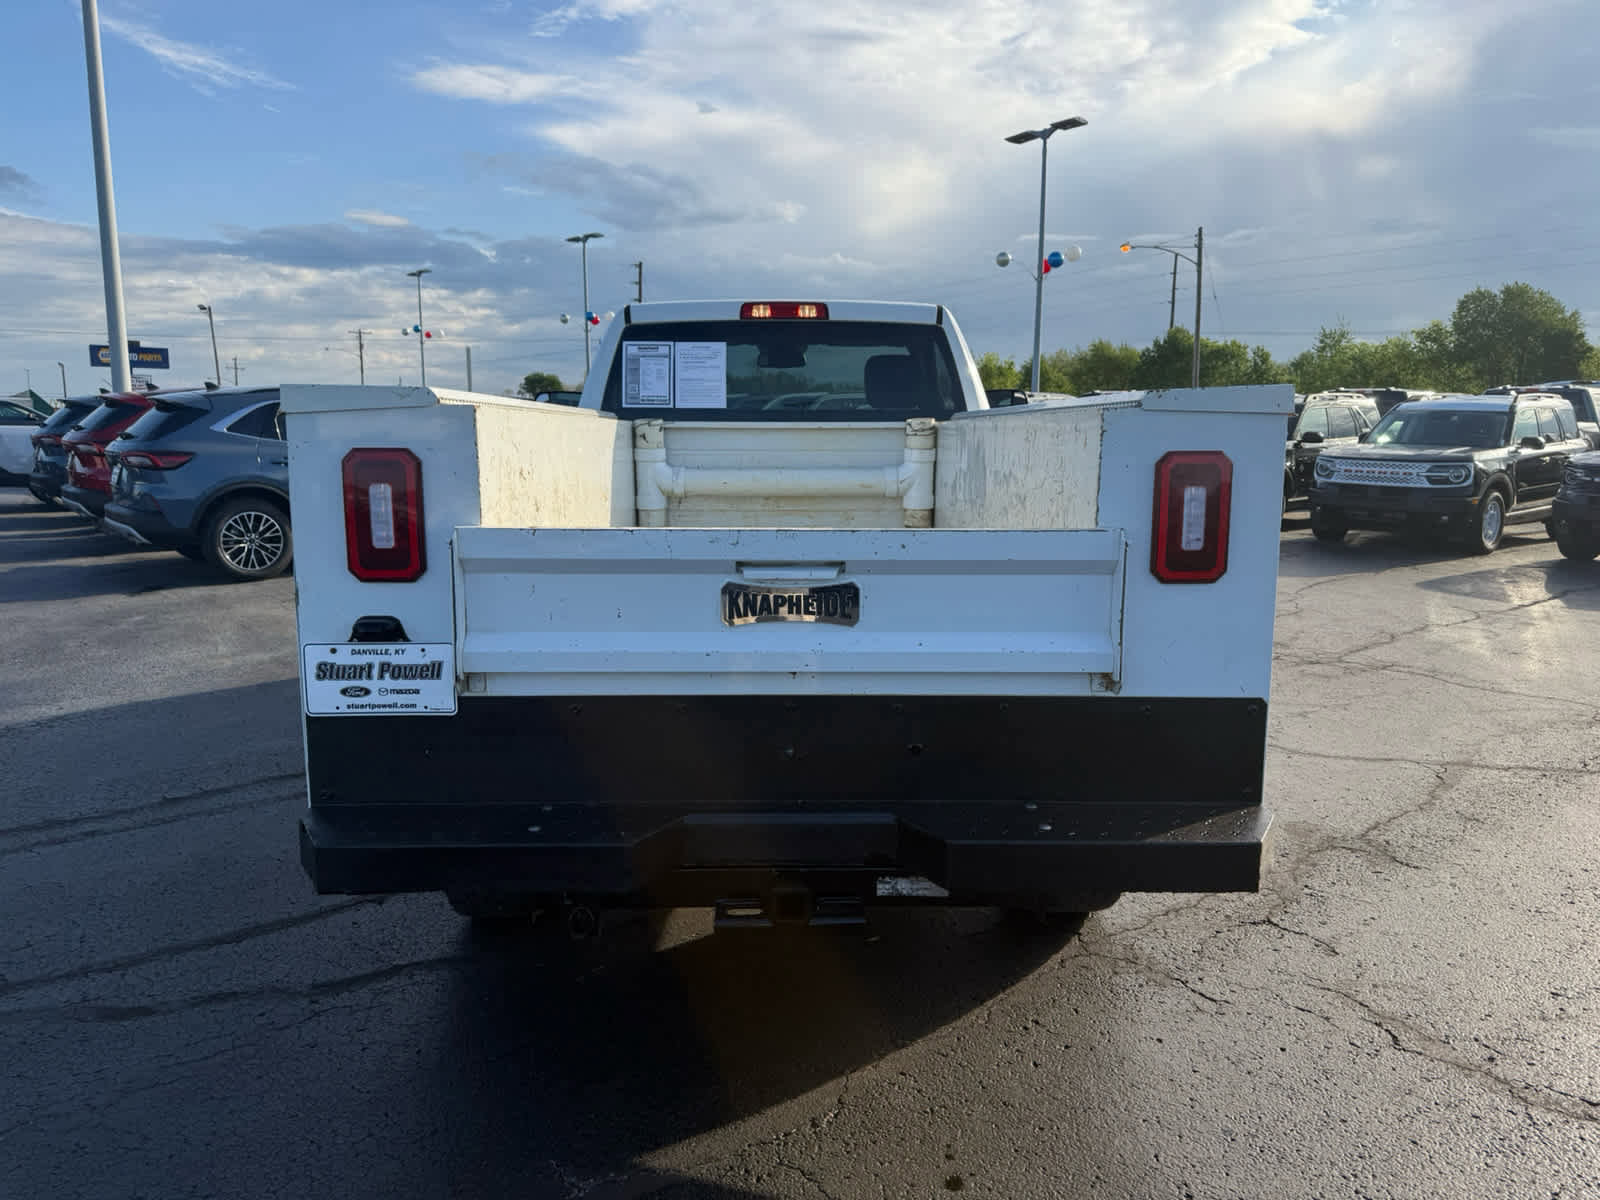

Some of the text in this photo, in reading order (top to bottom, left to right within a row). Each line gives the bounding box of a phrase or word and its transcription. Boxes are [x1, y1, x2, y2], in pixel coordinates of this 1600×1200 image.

[1343, 468, 1414, 476] BRONCO
[727, 590, 855, 620] KNAPHEIDE
[351, 648, 392, 656] DANVILLE,
[316, 660, 443, 681] Stuart Powell
[346, 702, 417, 710] stuartpowell.com
